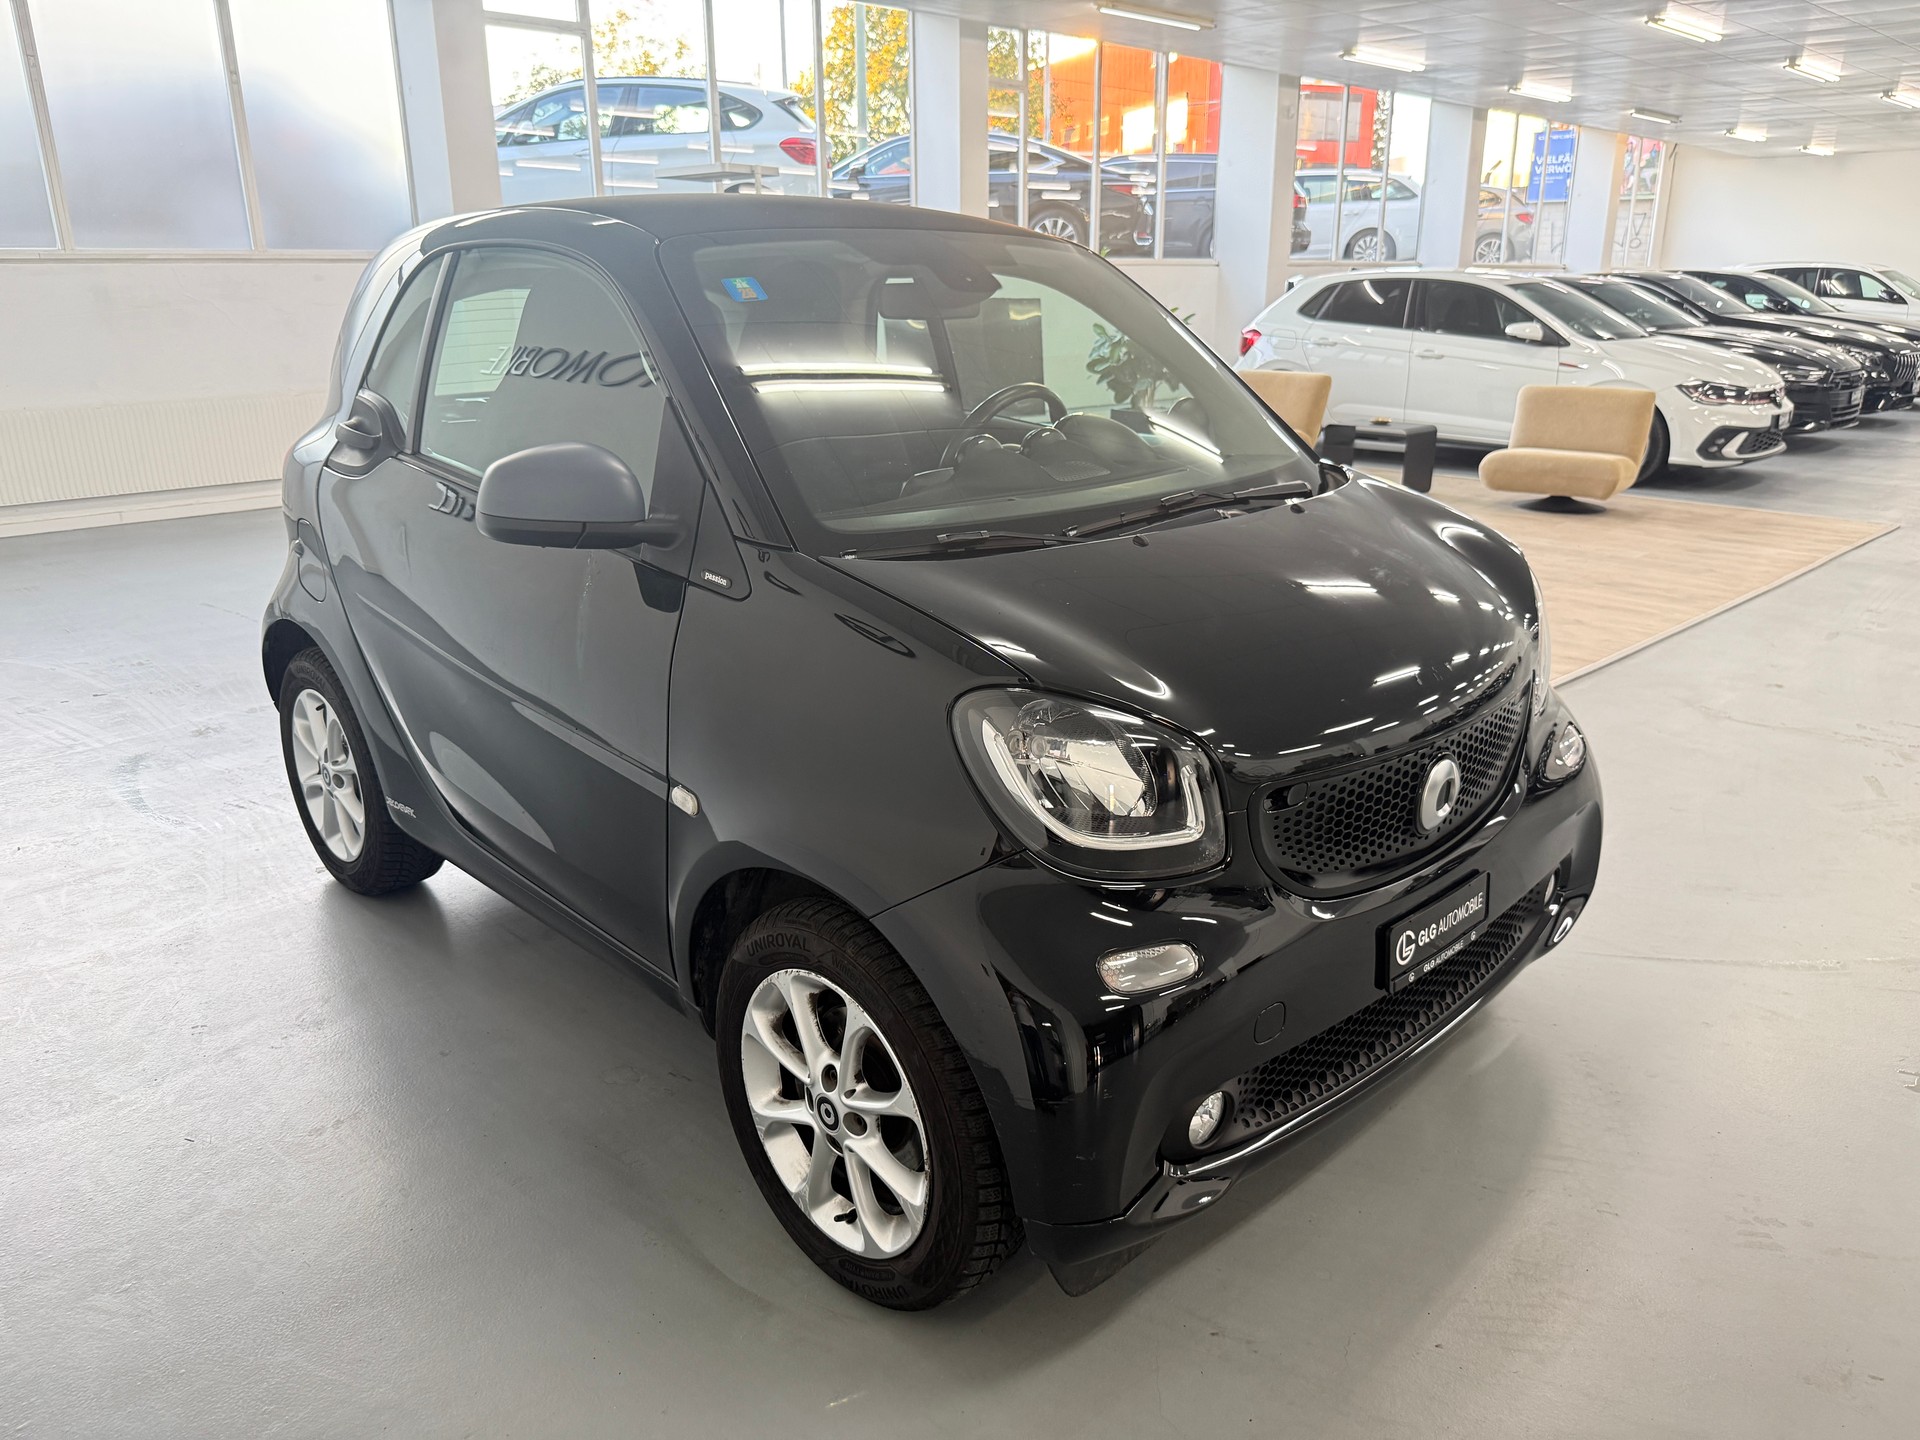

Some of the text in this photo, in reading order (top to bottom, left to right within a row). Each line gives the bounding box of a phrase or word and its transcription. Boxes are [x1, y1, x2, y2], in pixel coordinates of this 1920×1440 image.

[704, 572, 727, 586] passion
[1418, 892, 1483, 946] GLG AUTOMOBILE
[746, 932, 812, 957] UNIROYAL
[1423, 960, 1435, 972] GLG
[1435, 940, 1464, 964] AUTOMOBILE
